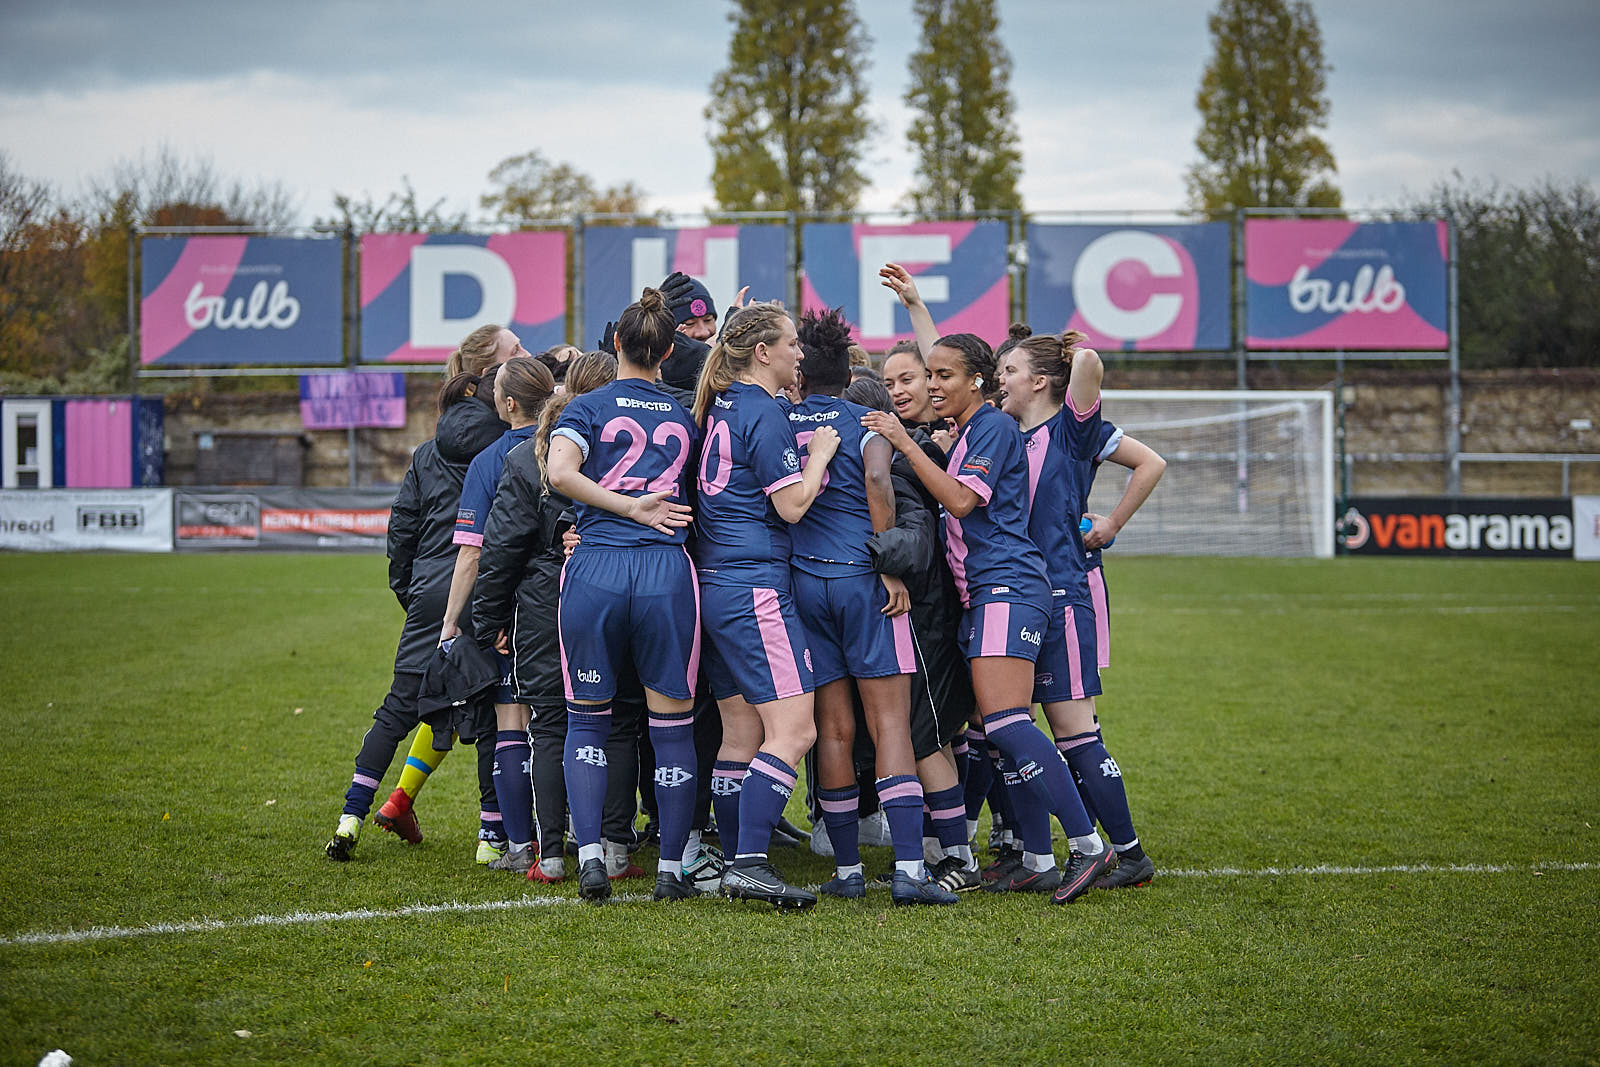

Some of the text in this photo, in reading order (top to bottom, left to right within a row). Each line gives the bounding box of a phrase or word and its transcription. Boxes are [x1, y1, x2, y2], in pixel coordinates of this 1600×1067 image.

[184, 280, 300, 329] bulb
[410, 245, 516, 348] D
[860, 235, 951, 338] F
[1072, 230, 1183, 341] C
[1288, 264, 1406, 313] bulb
[625, 398, 672, 412] DEFECTED
[598, 416, 690, 498] 22
[82, 513, 138, 528] FBB
[1369, 513, 1573, 550] vanarama
[577, 668, 601, 684] bulb
